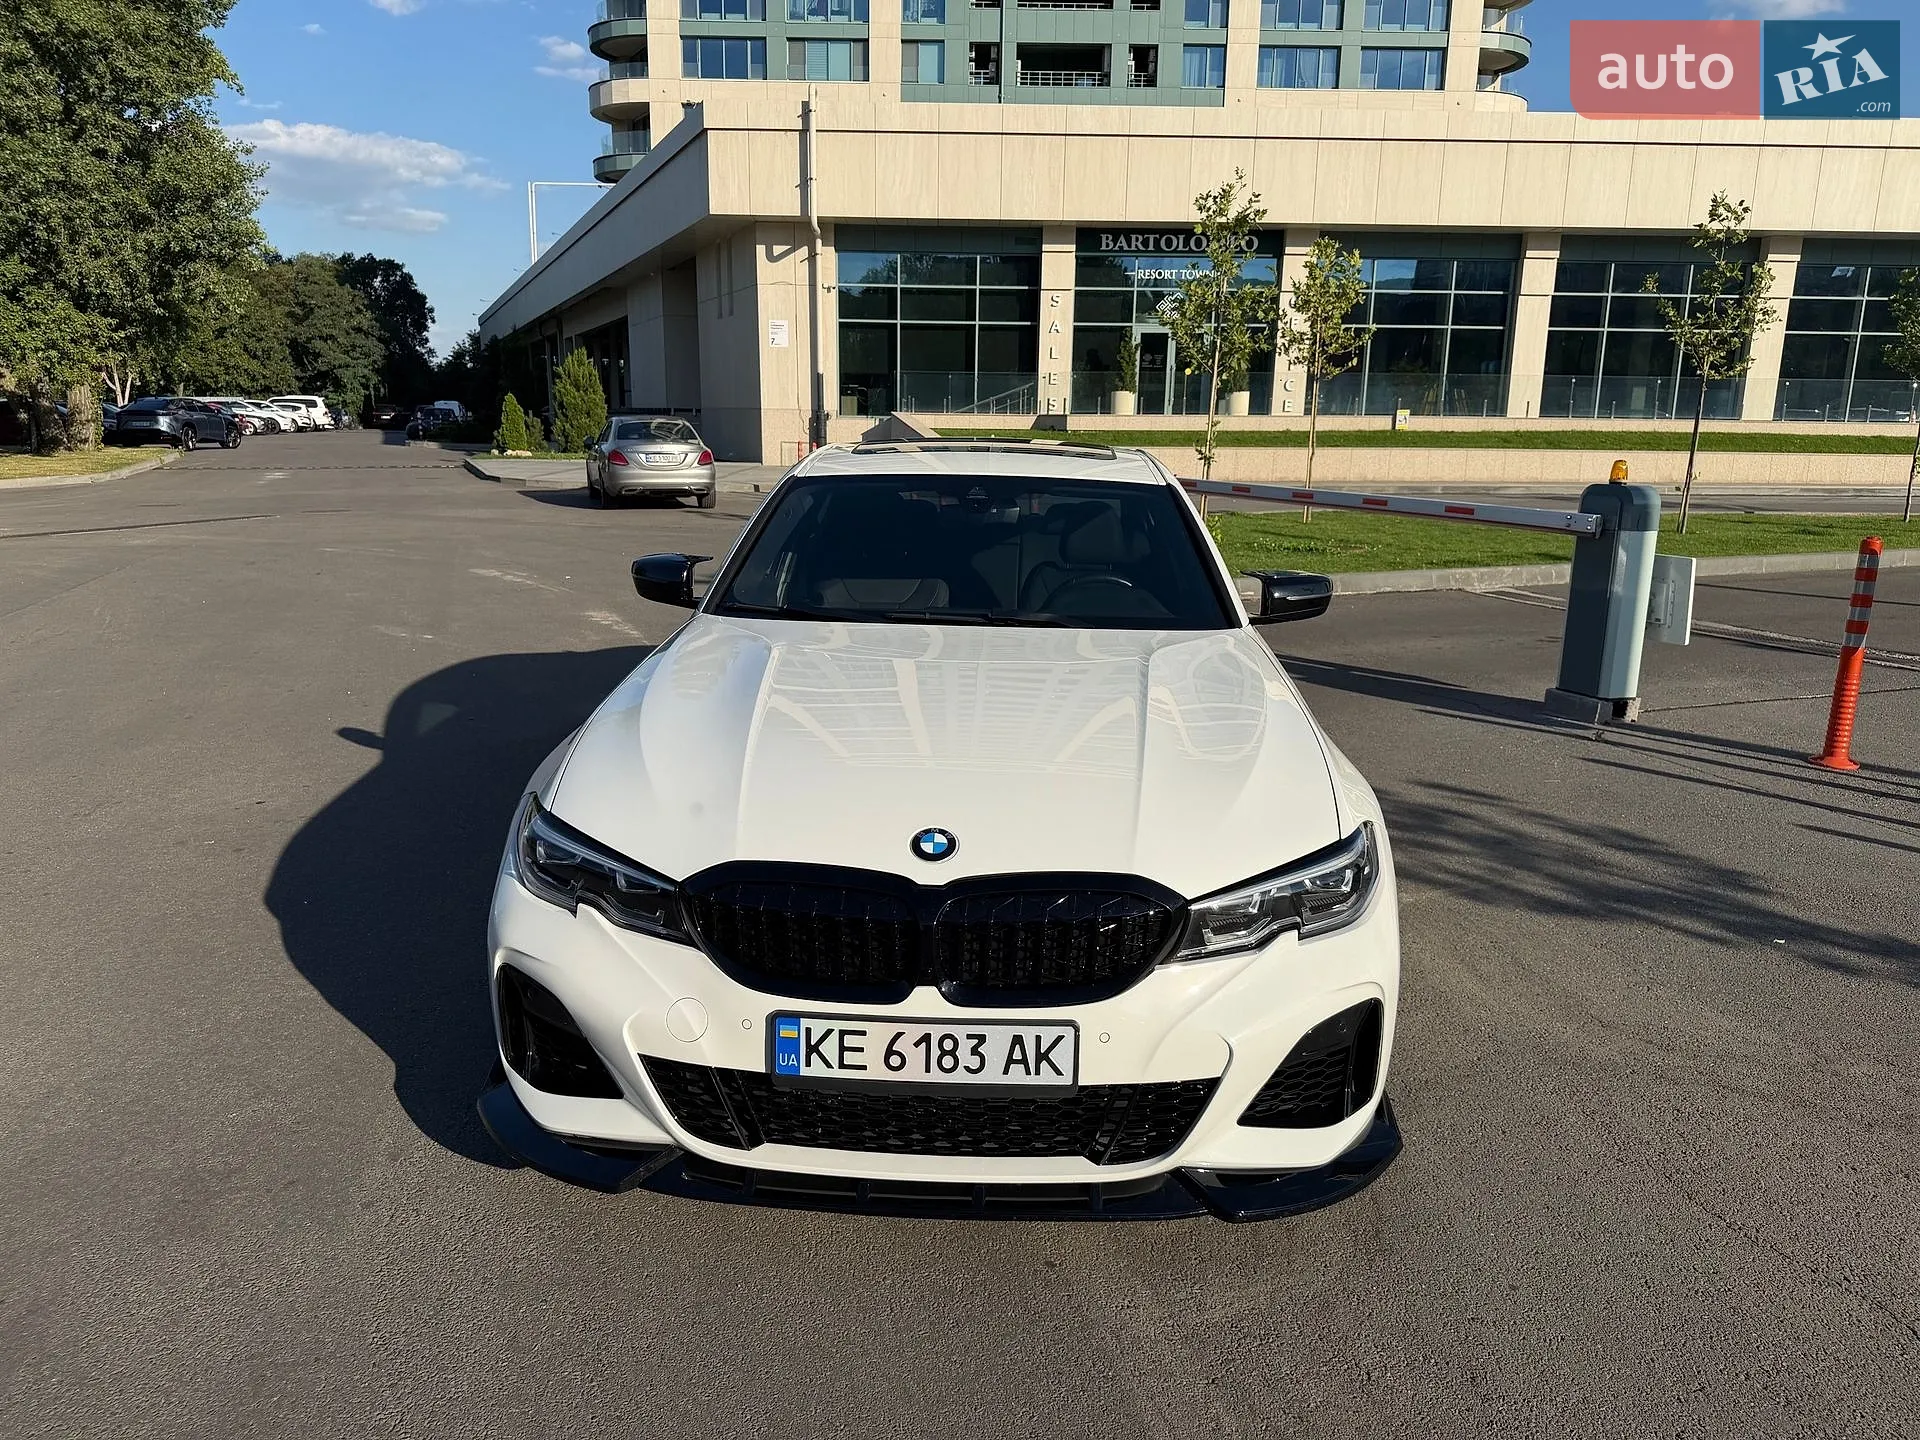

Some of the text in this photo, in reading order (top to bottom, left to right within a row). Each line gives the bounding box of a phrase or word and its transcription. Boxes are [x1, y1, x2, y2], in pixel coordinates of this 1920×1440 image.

[1099, 233, 1259, 252] BARTOLOEO
[1137, 269, 1178, 280] RESORT
[1048, 295, 1061, 413] SALES
[779, 1052, 798, 1067] UA
[804, 1026, 1066, 1077] KE 6183 AK
